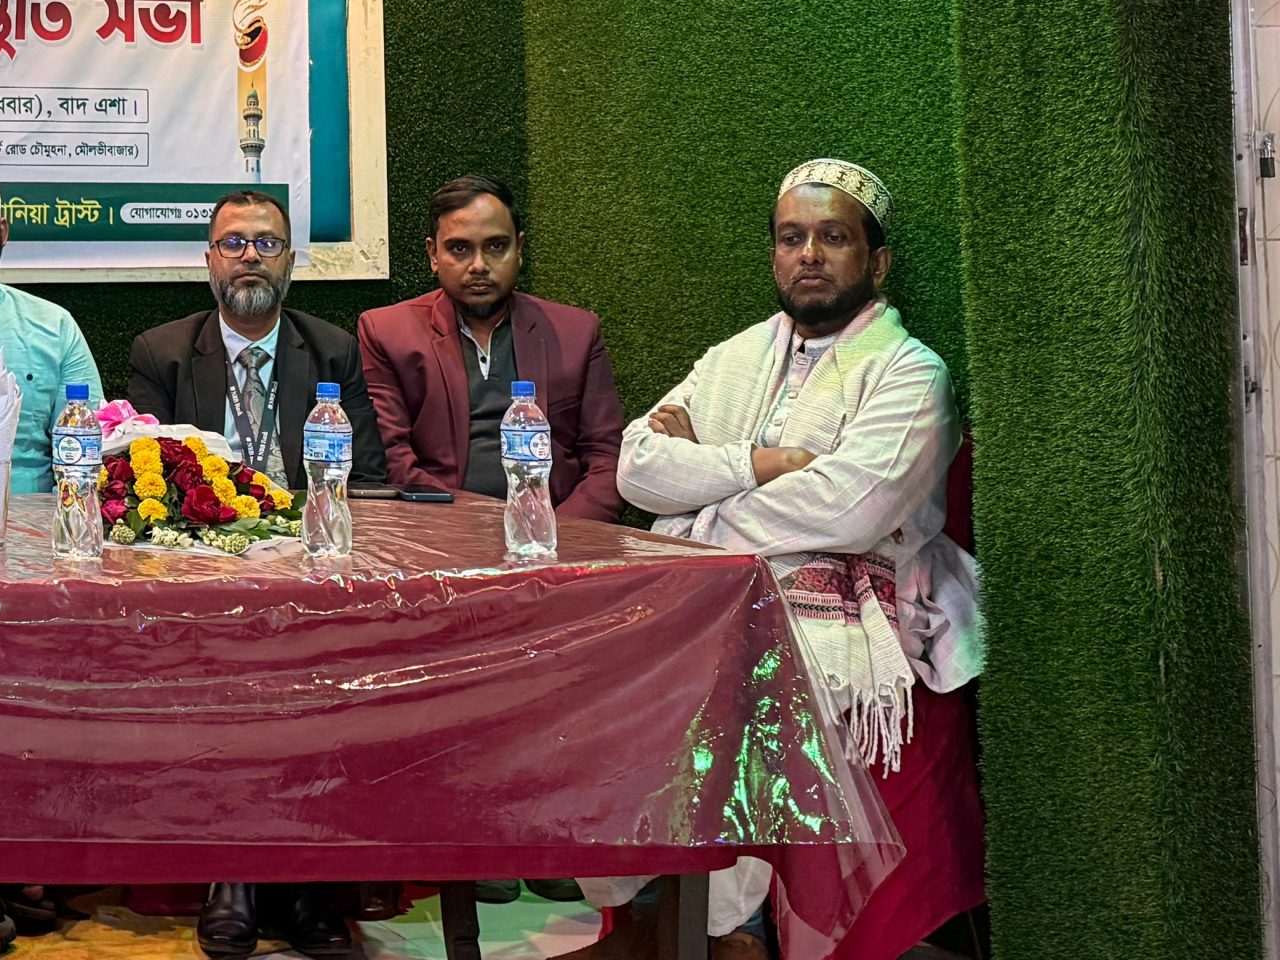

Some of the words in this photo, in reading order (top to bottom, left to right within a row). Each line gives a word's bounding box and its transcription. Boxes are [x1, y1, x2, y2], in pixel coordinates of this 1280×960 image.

[57, 96, 89, 116] বাদ
[5, 143, 27, 156] রোড
[75, 141, 139, 159] মৌলভীবাজার)
[129, 207, 182, 220] যোগাযোগঃ
